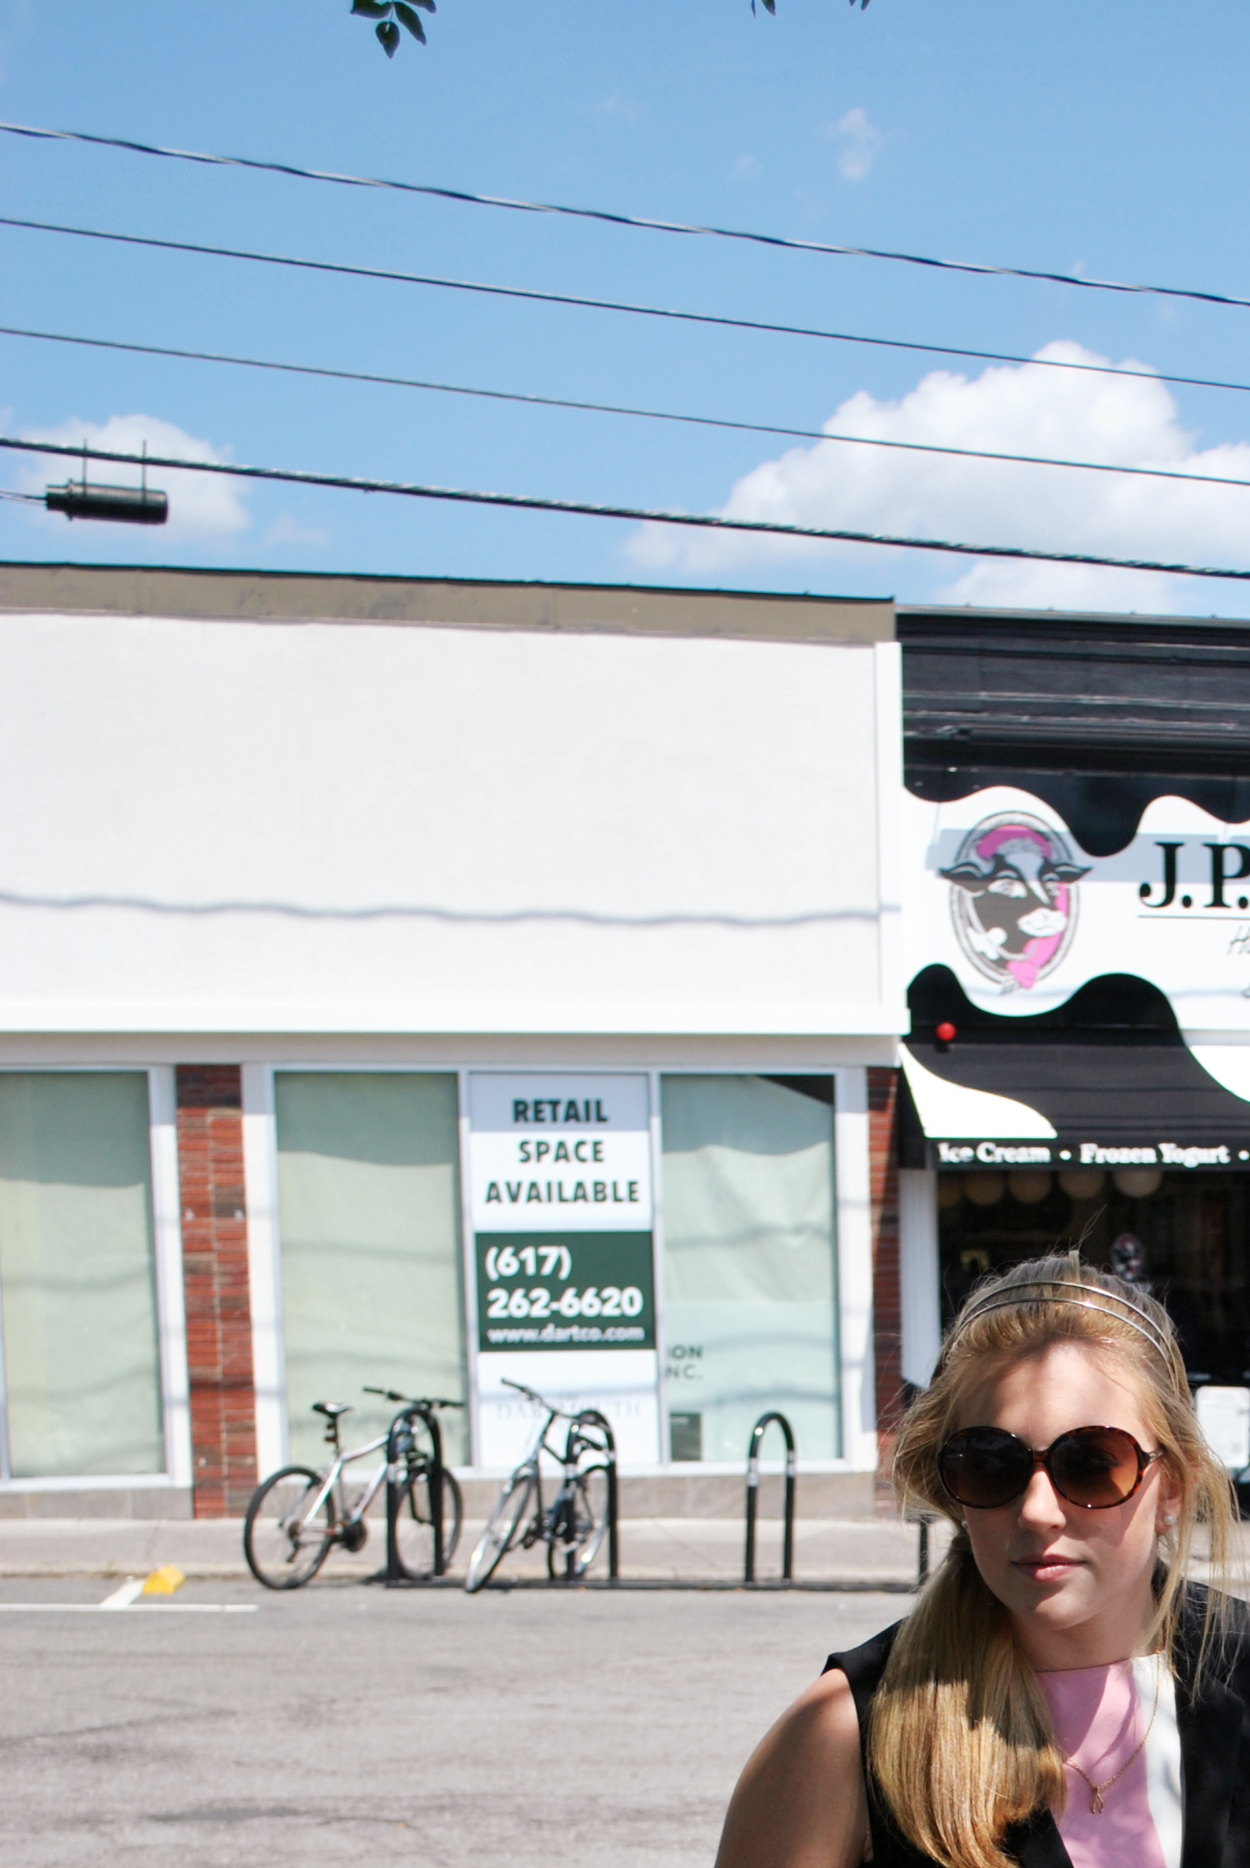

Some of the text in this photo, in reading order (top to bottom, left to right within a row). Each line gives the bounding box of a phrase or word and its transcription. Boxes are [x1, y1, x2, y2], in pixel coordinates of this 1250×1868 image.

[511, 1097, 609, 1124] RETAIL
[518, 1139, 605, 1164] SPACE
[937, 1141, 974, 1164] Ice
[976, 1141, 1051, 1164] Cream
[1079, 1142, 1157, 1165] Frozen
[1157, 1142, 1231, 1169] Yogurt
[485, 1180, 640, 1204] AVAILABLE
[485, 1245, 572, 1282] (617)
[486, 1286, 644, 1319] 262-6620
[487, 1323, 645, 1344] www.dartco.com
